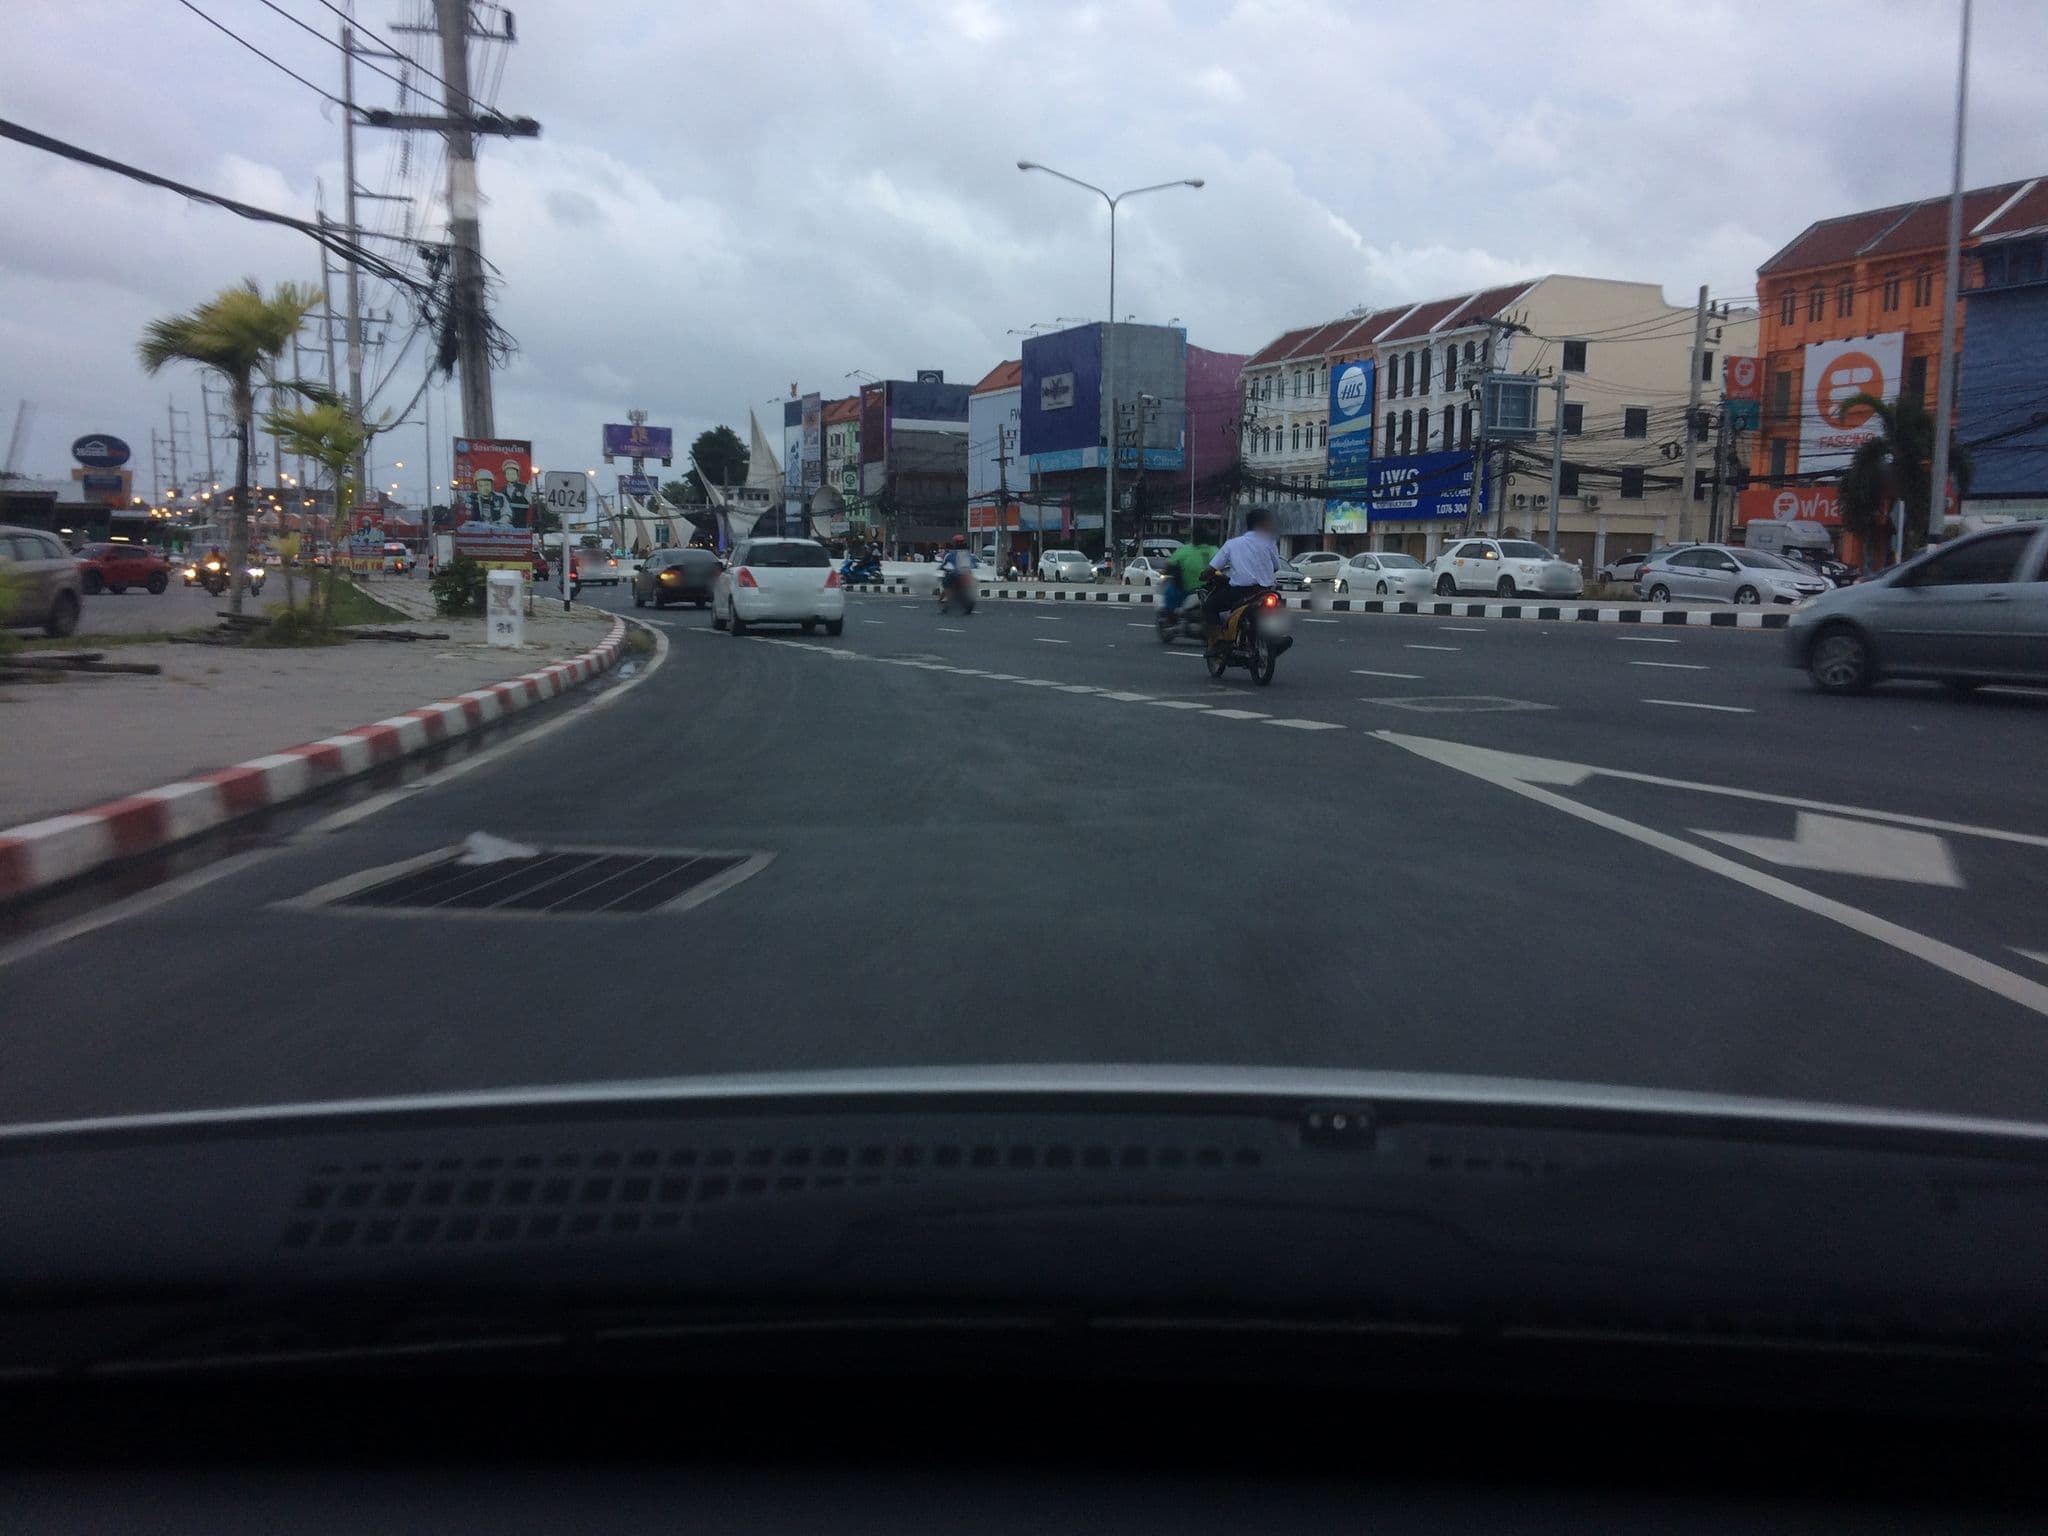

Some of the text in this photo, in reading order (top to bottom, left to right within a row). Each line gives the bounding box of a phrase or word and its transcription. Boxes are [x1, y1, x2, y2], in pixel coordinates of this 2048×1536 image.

[1372, 468, 1419, 497] JWS
[548, 488, 586, 507] 4024
[1453, 503, 1467, 513] 304
